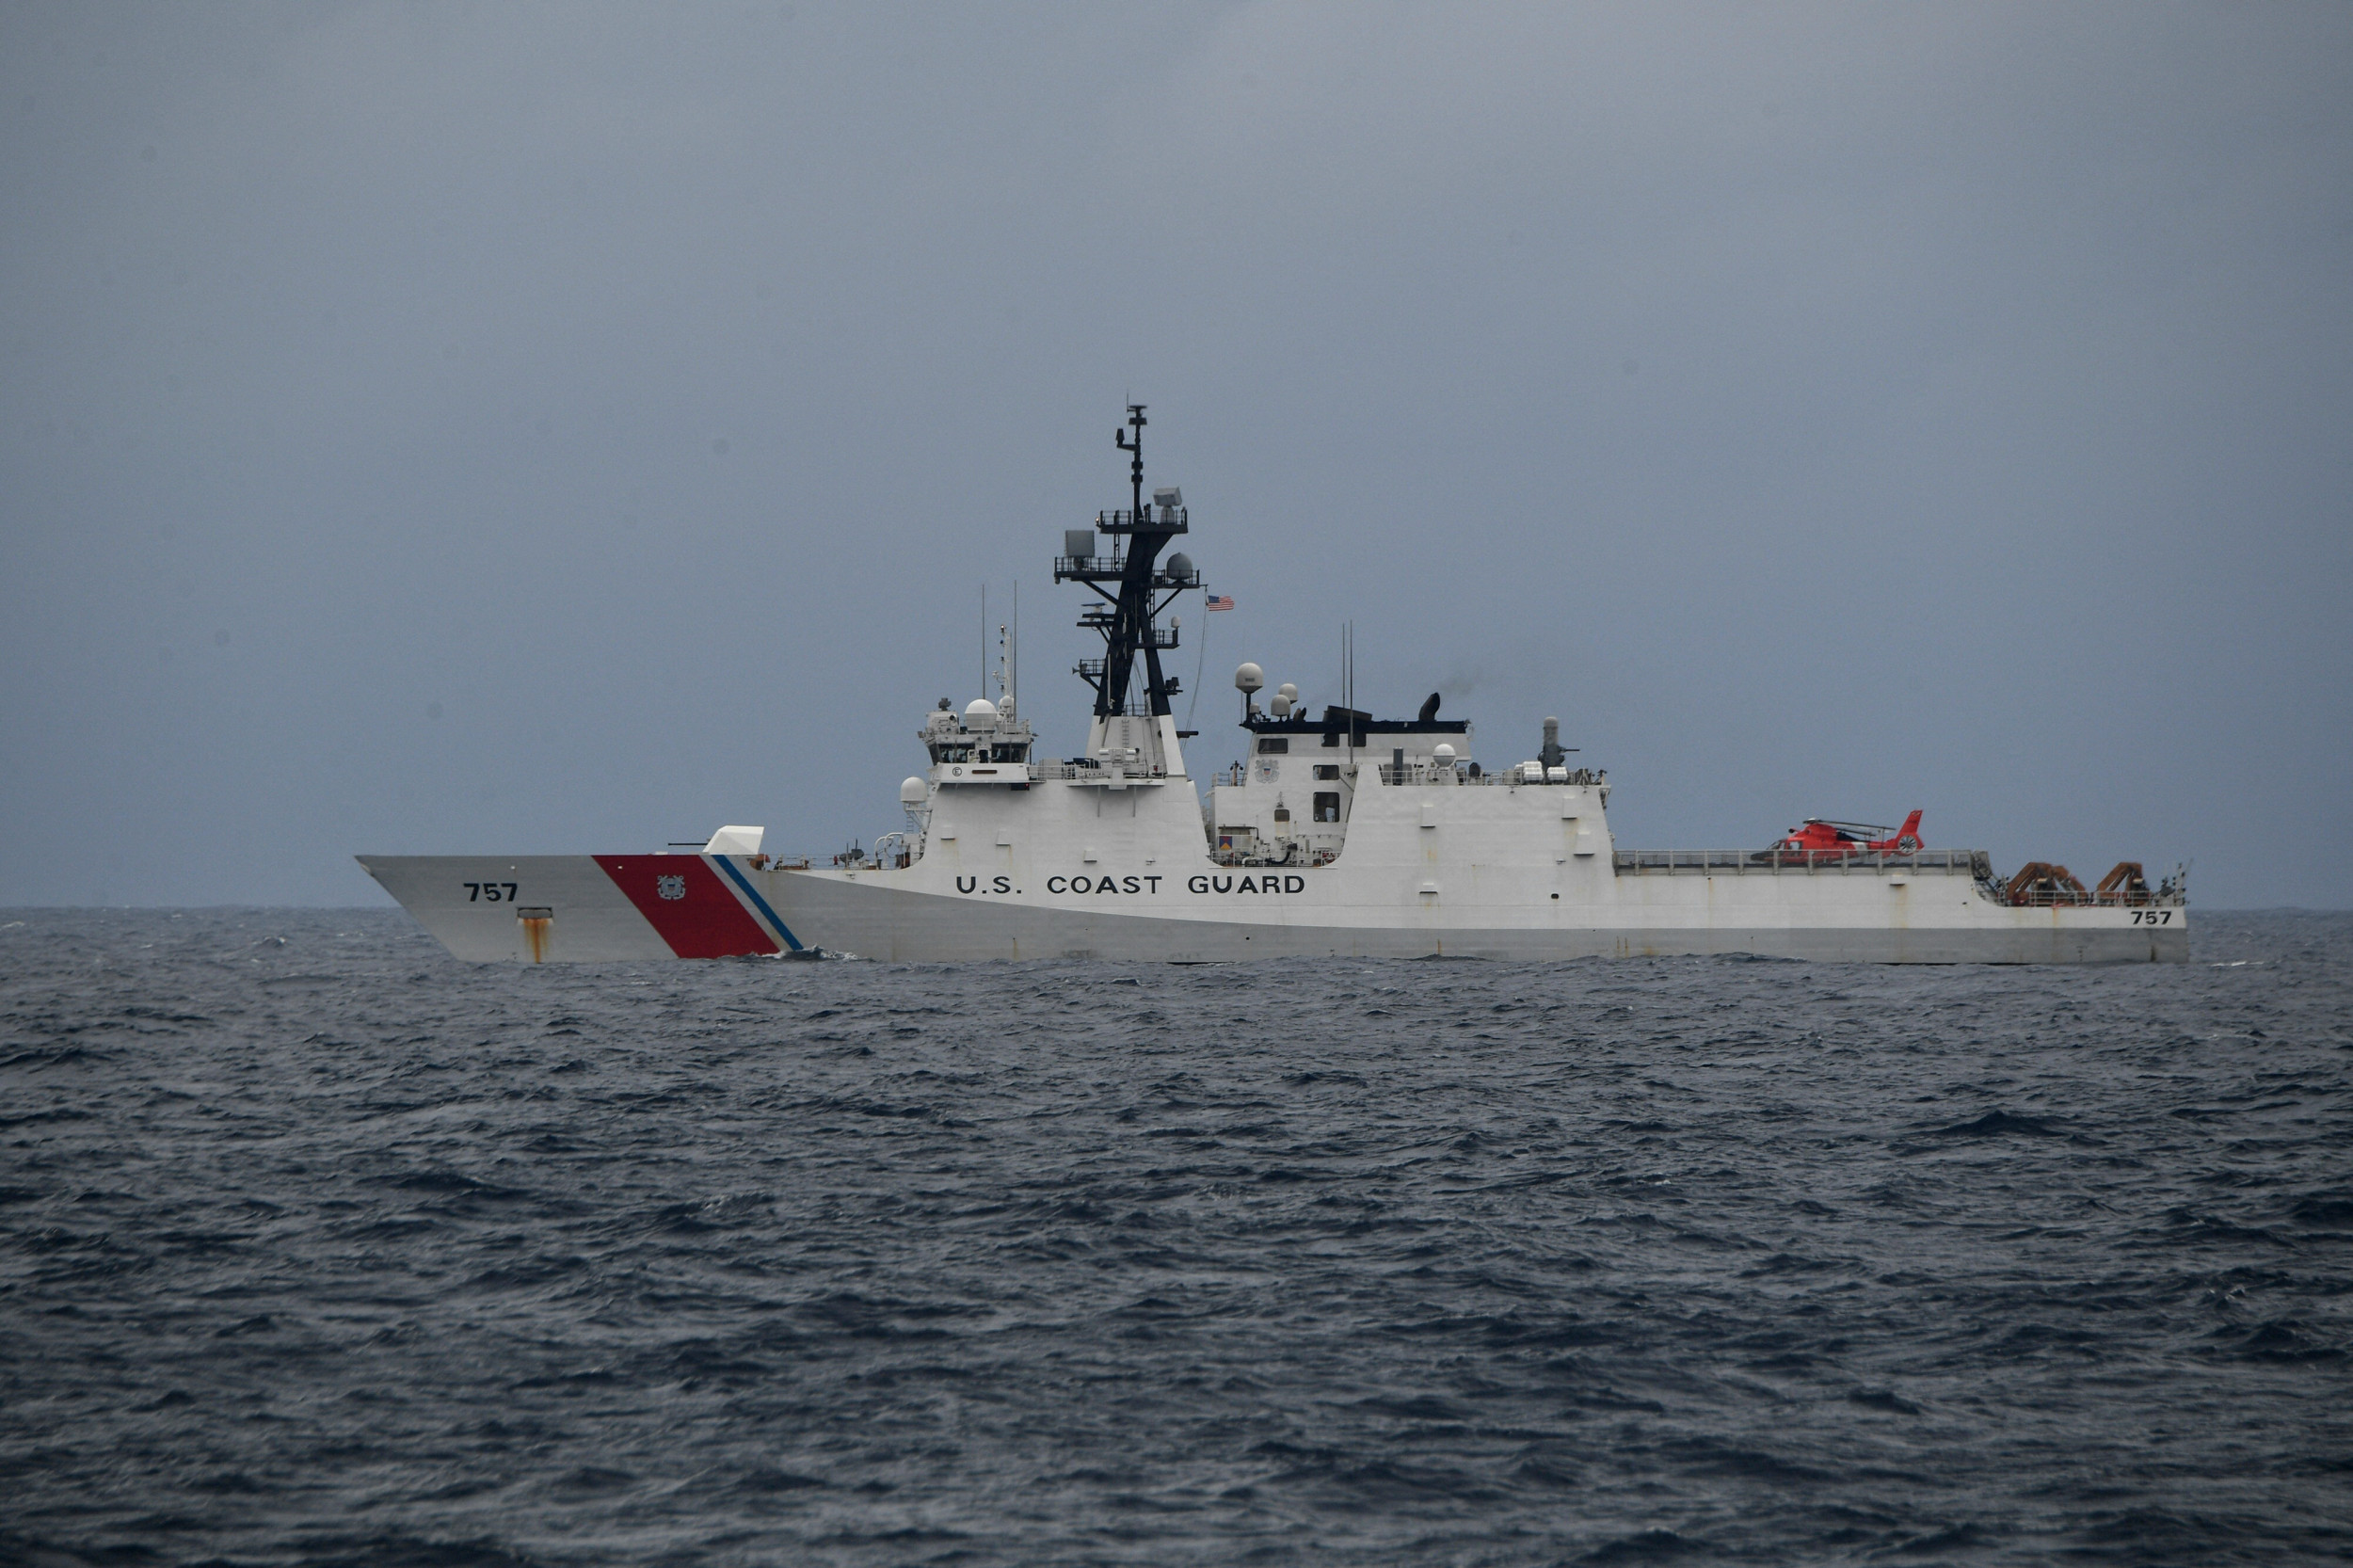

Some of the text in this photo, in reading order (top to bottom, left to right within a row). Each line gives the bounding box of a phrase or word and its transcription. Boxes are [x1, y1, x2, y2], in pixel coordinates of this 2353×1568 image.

[463, 883, 518, 903] 757
[956, 875, 1305, 894] U.S. COAST GUARD
[2130, 910, 2172, 925] 757
